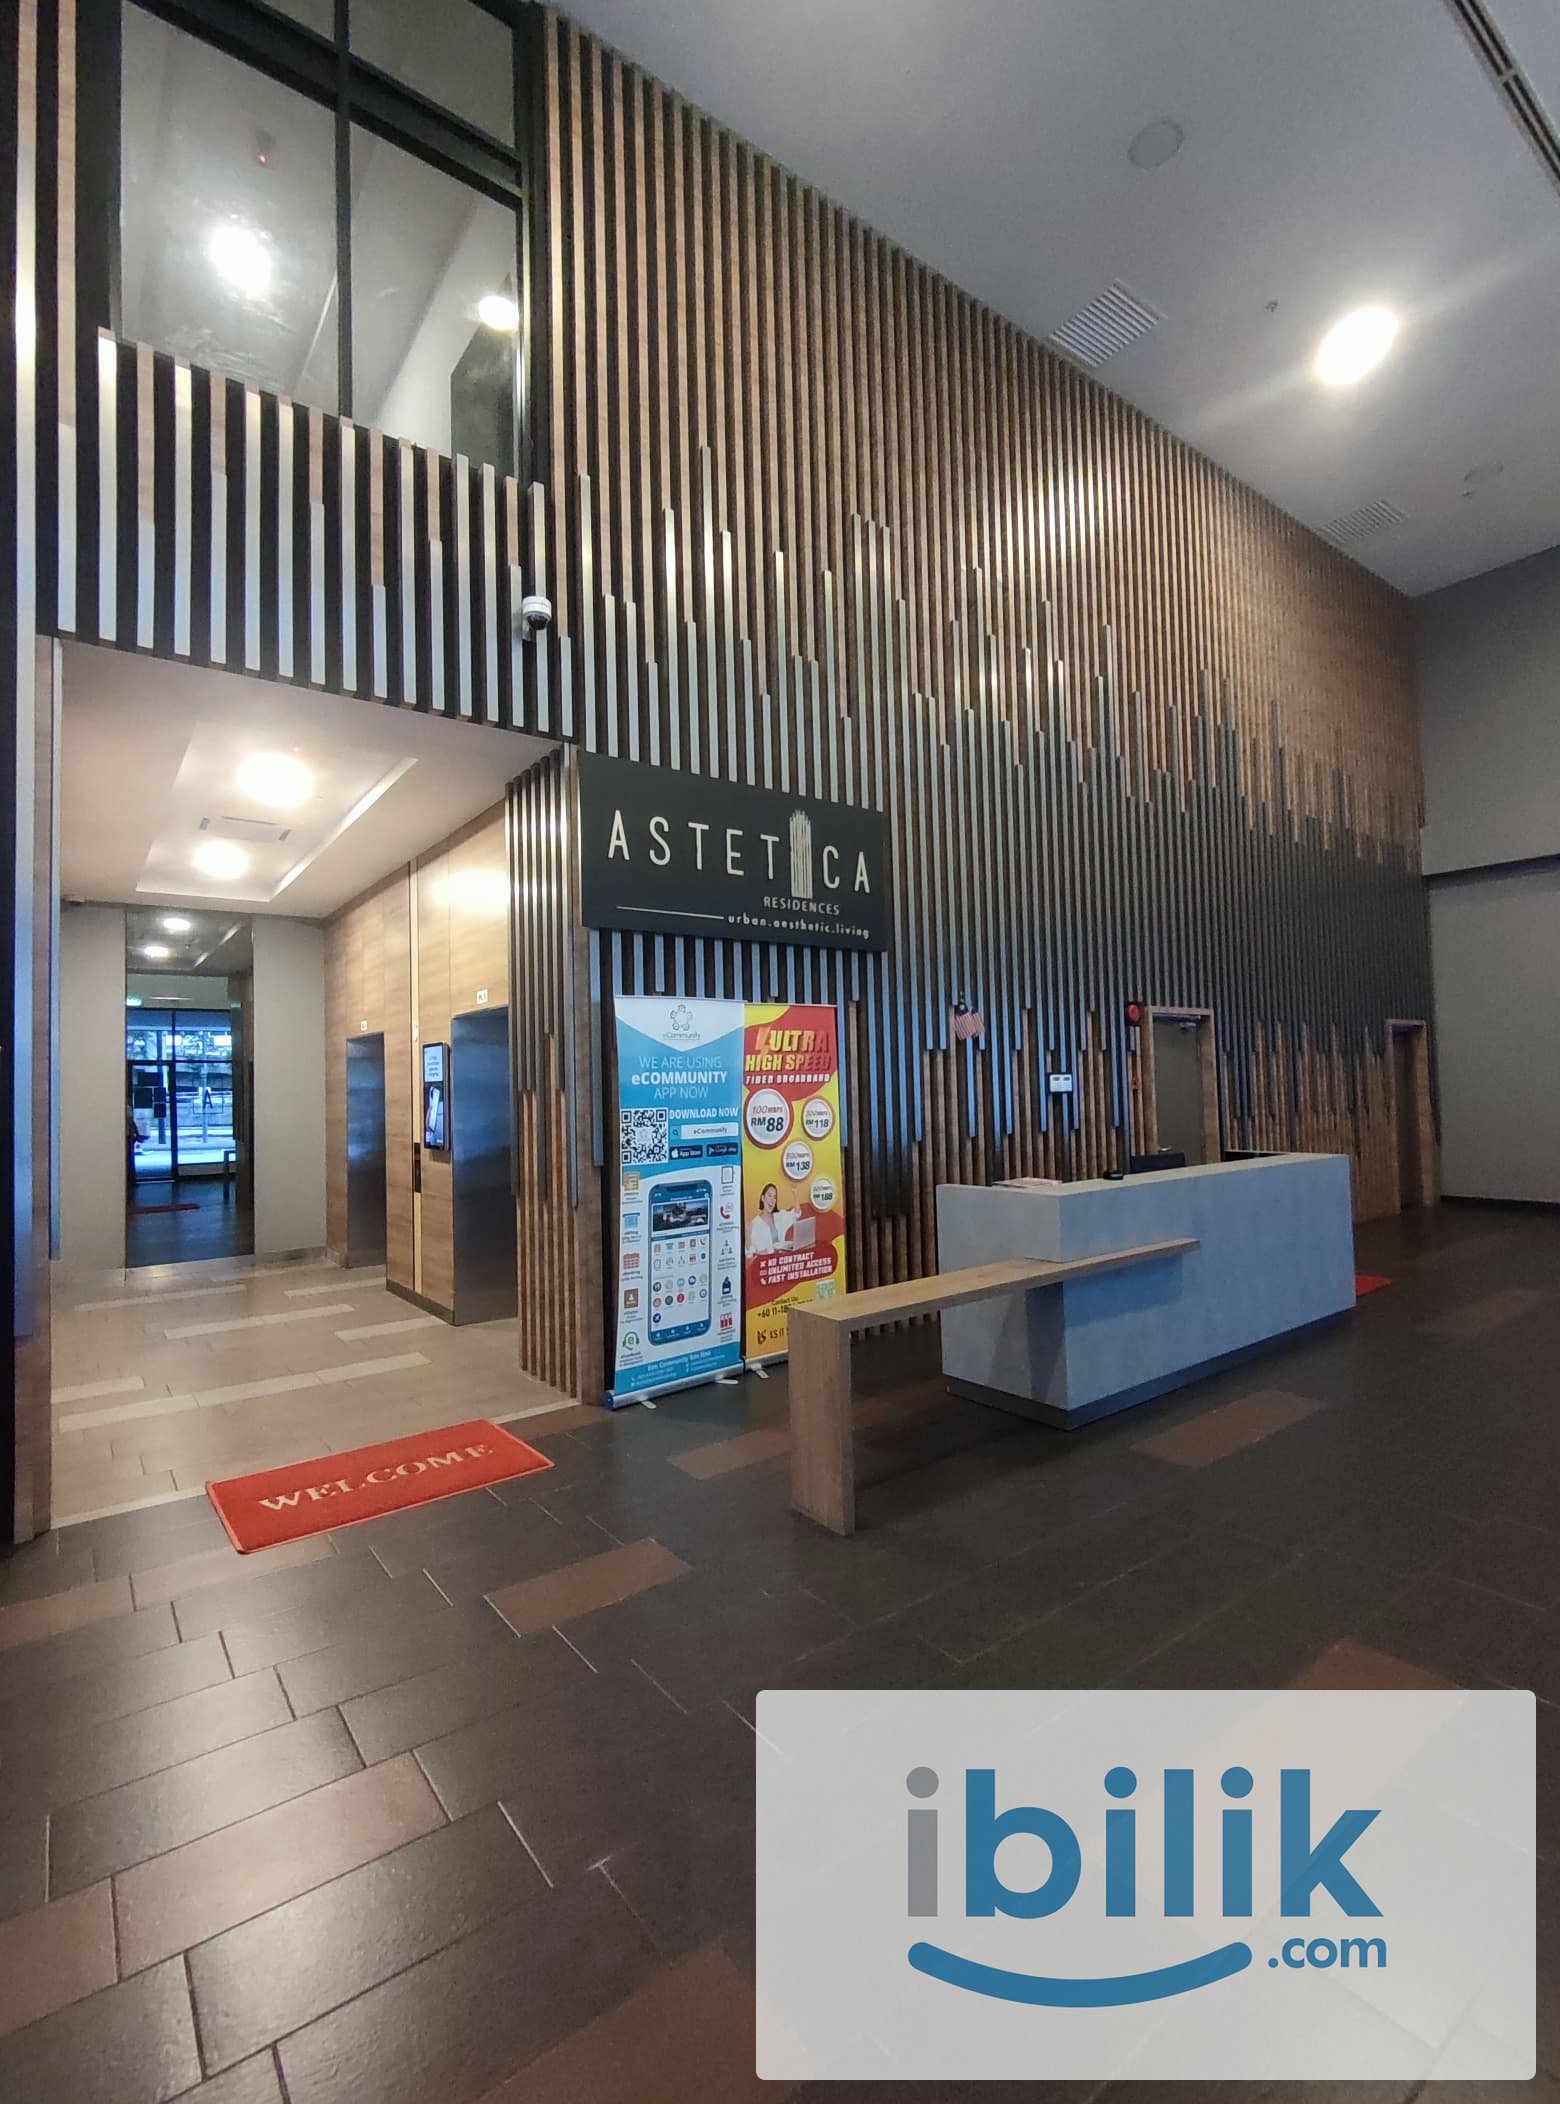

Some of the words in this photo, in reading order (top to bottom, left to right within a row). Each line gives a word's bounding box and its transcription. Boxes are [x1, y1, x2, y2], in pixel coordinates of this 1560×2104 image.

[764, 896, 840, 915] RESIDENCES
[728, 913, 870, 939] urban.aesthetic.living
[769, 1030, 829, 1052] ULTRA
[640, 1056, 658, 1069] WE
[662, 1056, 683, 1068] ARE
[687, 1055, 722, 1068] USING
[745, 1054, 783, 1072] HIGH
[785, 1053, 831, 1071] SPEED
[631, 1071, 728, 1085] eCOMMUNITY
[654, 1087, 677, 1100] APP
[680, 1086, 709, 1098] NOW
[669, 1108, 717, 1120] DOWNLOAD
[719, 1107, 739, 1117] NOW
[693, 1127, 728, 1136] eCommunity
[768, 1262, 805, 1275] UNLIMITED
[806, 1256, 832, 1267] ACCESS
[779, 1252, 814, 1264] CONTRACT
[768, 1273, 786, 1284] FAST
[787, 1266, 832, 1280] INSTALLATION
[258, 1444, 494, 1512] WELCOME
